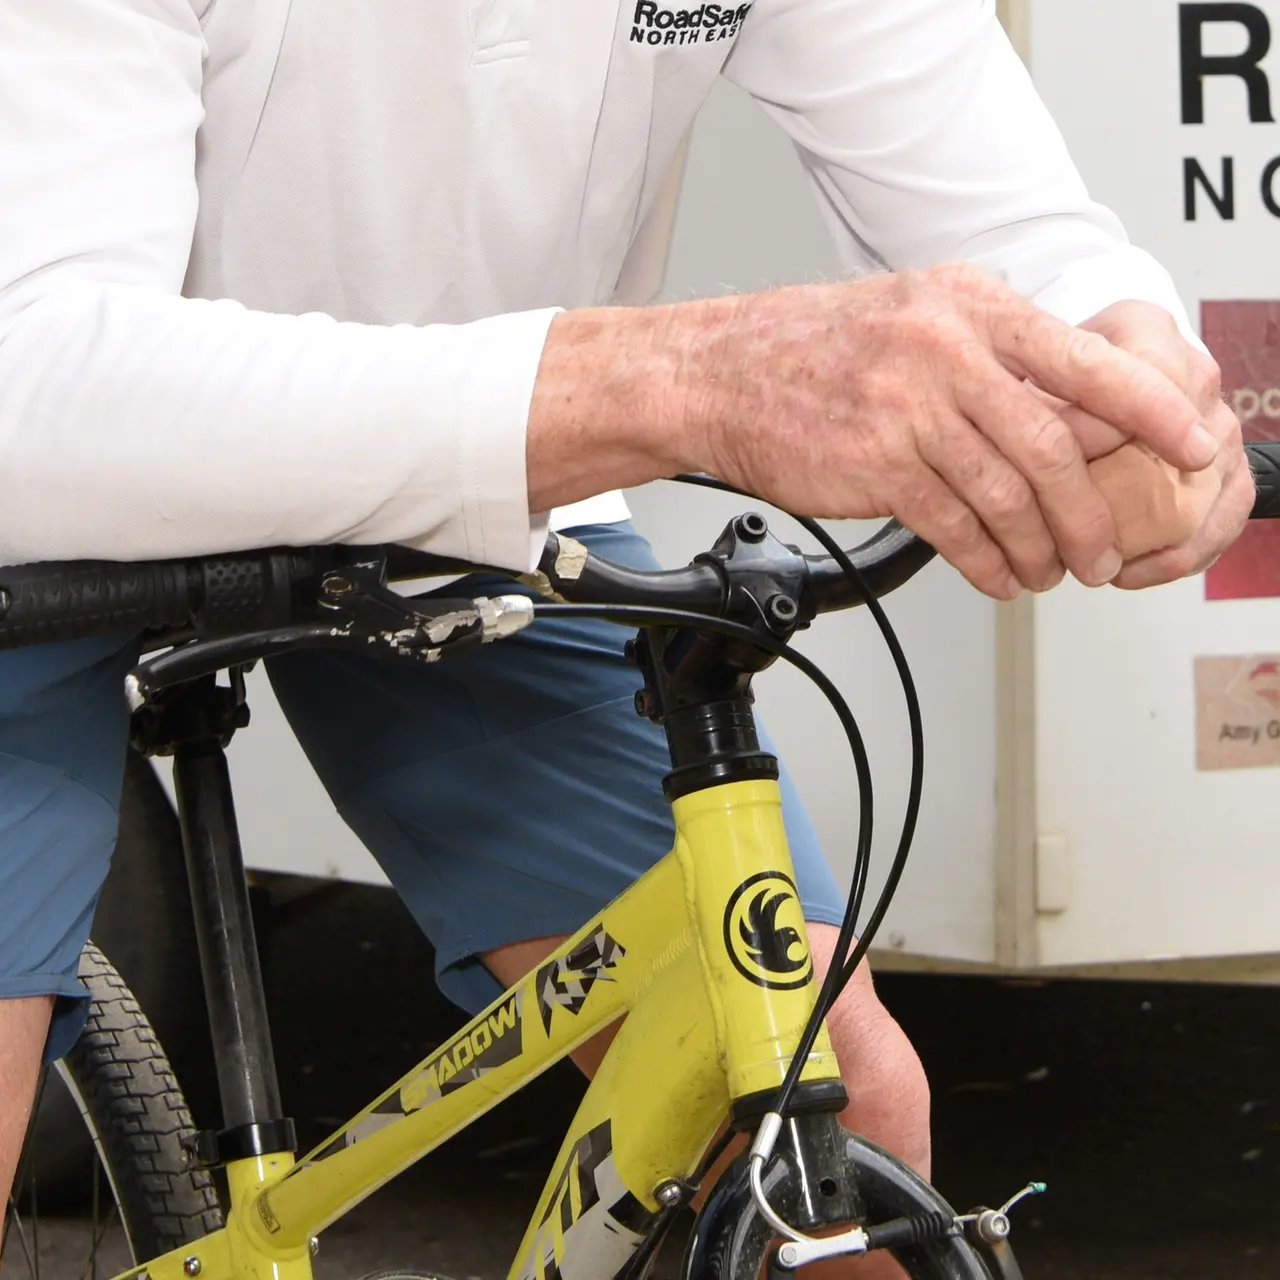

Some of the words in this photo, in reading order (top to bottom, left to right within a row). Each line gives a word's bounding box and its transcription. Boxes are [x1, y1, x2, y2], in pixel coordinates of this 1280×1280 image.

[630, 26, 700, 45] NORTH
[705, 22, 744, 42] EAS
[401, 996, 517, 1114] SHADOW
